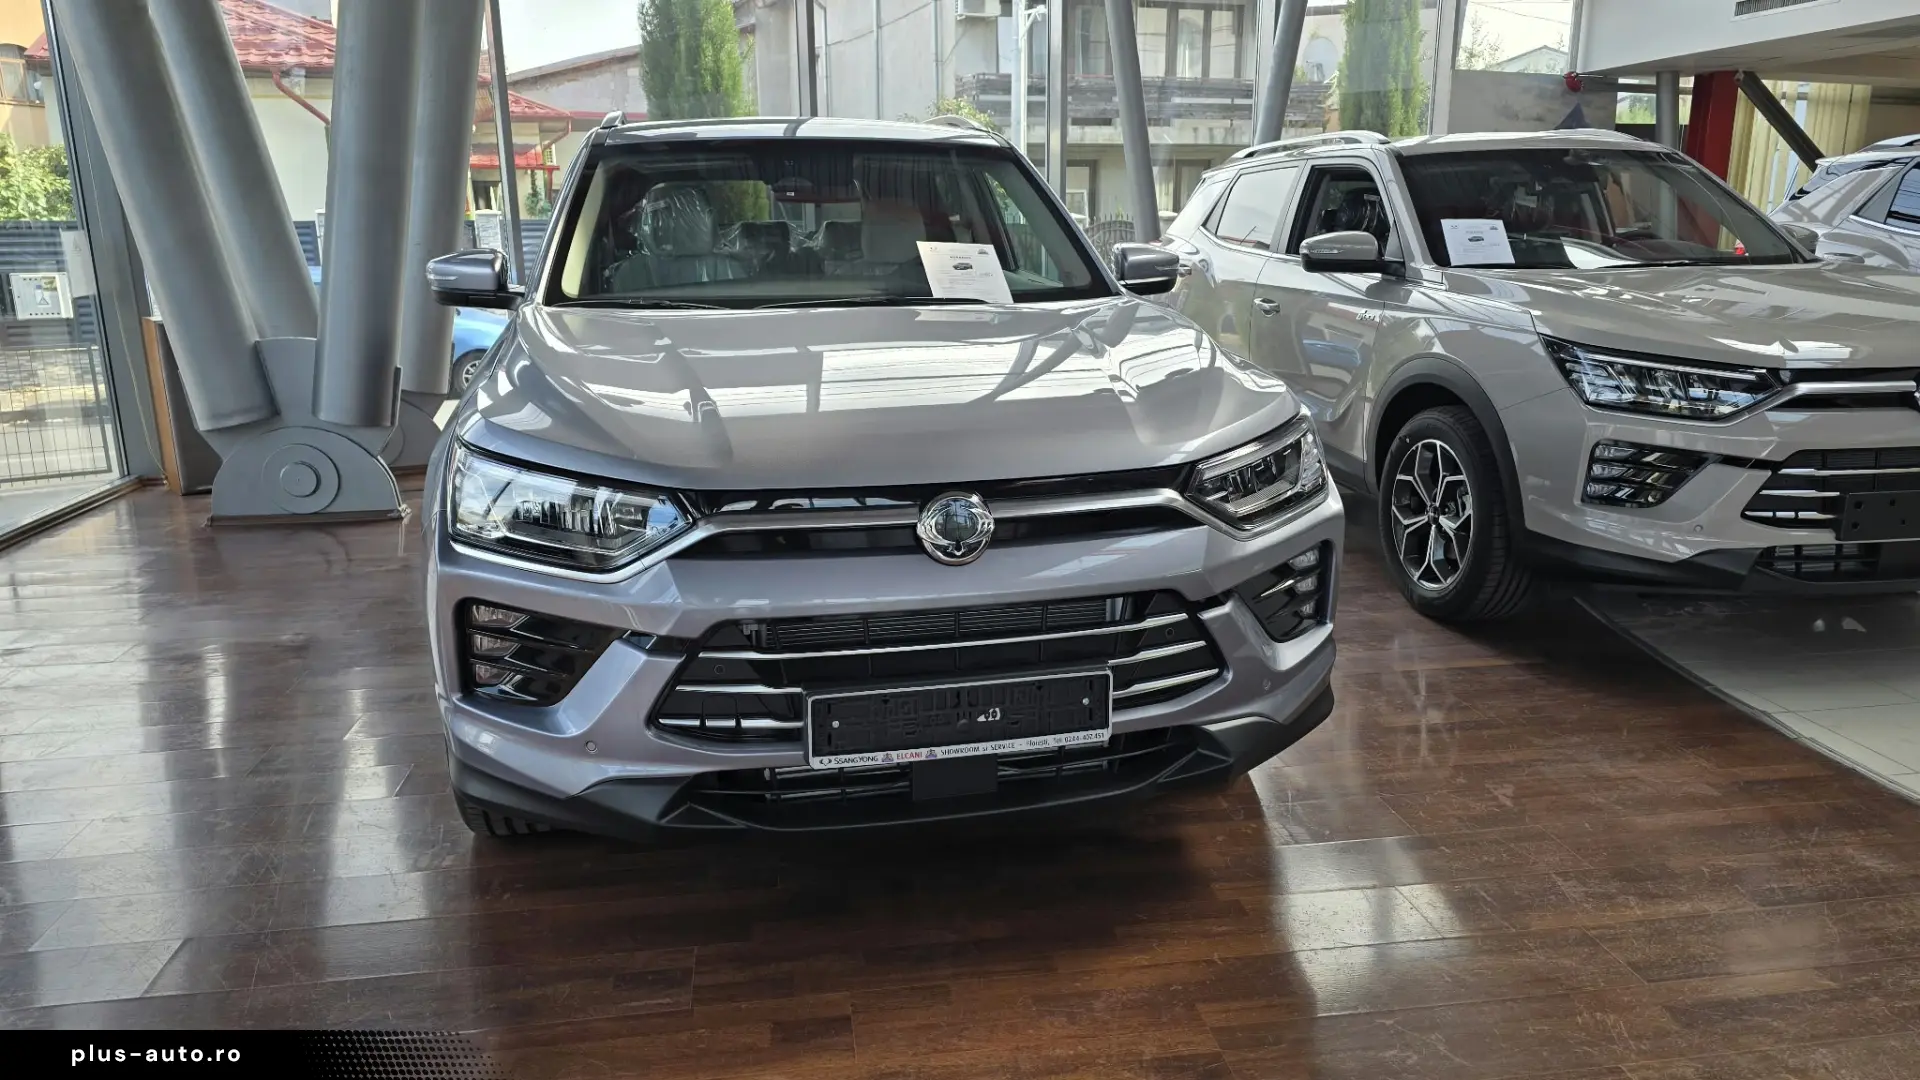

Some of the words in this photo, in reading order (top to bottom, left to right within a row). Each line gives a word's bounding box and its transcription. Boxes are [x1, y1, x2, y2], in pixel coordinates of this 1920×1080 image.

[834, 756, 879, 765] SSANGYONG
[896, 751, 923, 760] ELCANI
[940, 746, 980, 756] SHOWROOM
[990, 742, 1015, 751] SERVICE
